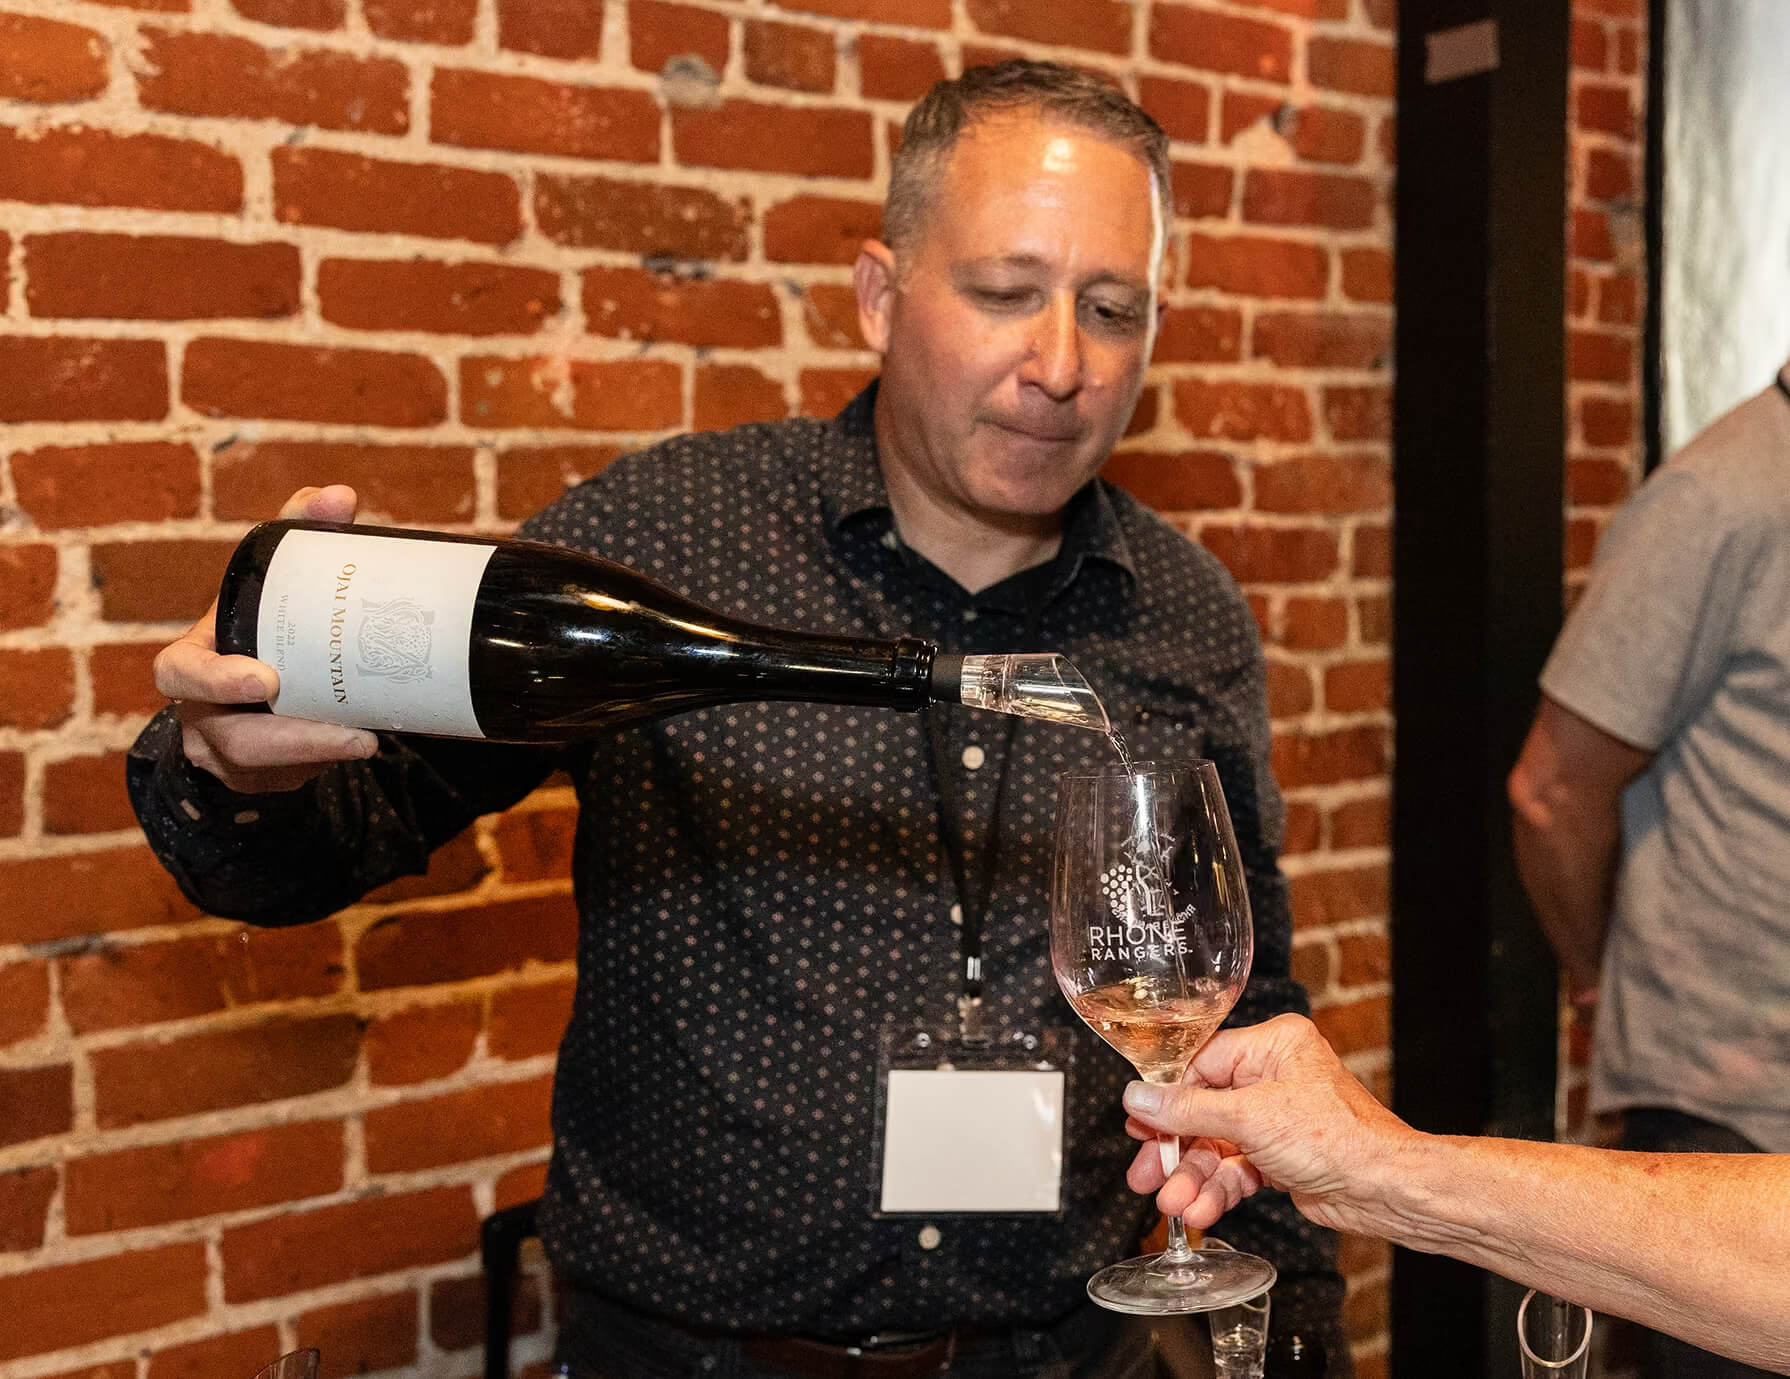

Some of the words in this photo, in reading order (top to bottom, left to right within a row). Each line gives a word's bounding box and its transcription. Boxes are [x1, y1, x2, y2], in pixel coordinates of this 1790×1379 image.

[335, 562, 357, 601] OJAI
[276, 593, 289, 633] WHITE
[276, 635, 288, 671] BLEND
[287, 622, 297, 647] 2022
[328, 607, 349, 705] MOUNTAIN
[1090, 920, 1187, 947] RHONE
